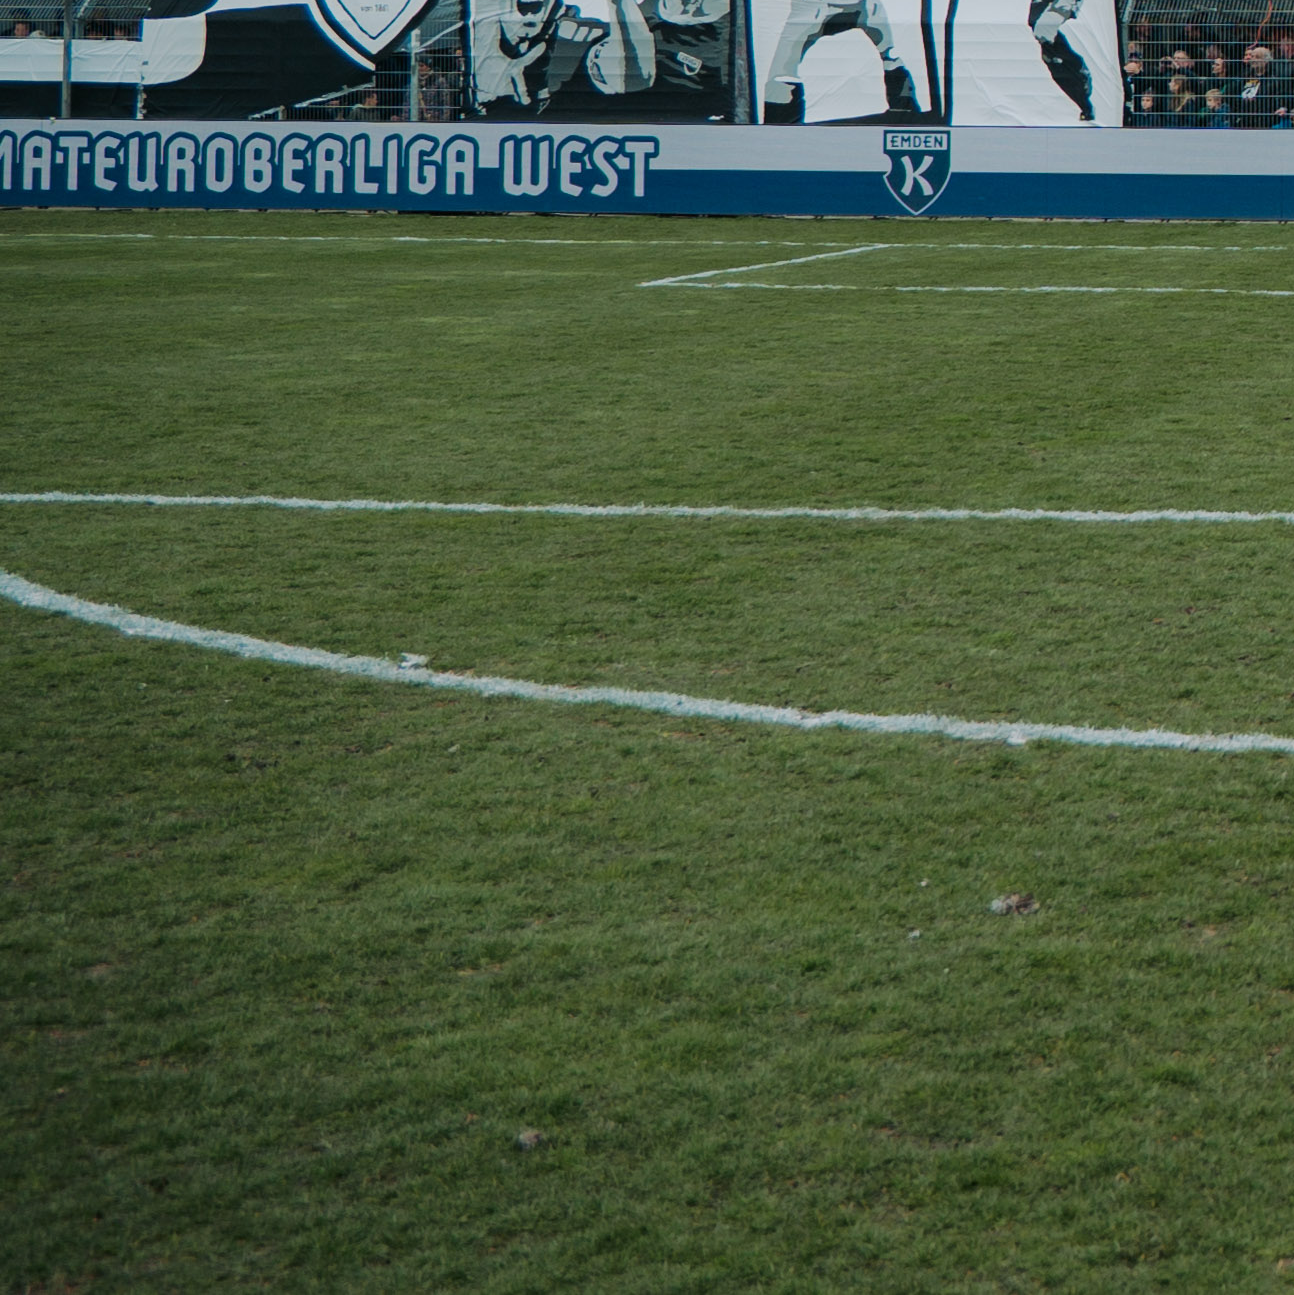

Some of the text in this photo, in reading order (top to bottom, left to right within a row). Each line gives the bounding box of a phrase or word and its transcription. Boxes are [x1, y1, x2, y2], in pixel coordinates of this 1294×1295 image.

[890, 135, 944, 148] EMDEN
[502, 138, 660, 198] WEST
[900, 155, 934, 196] K
